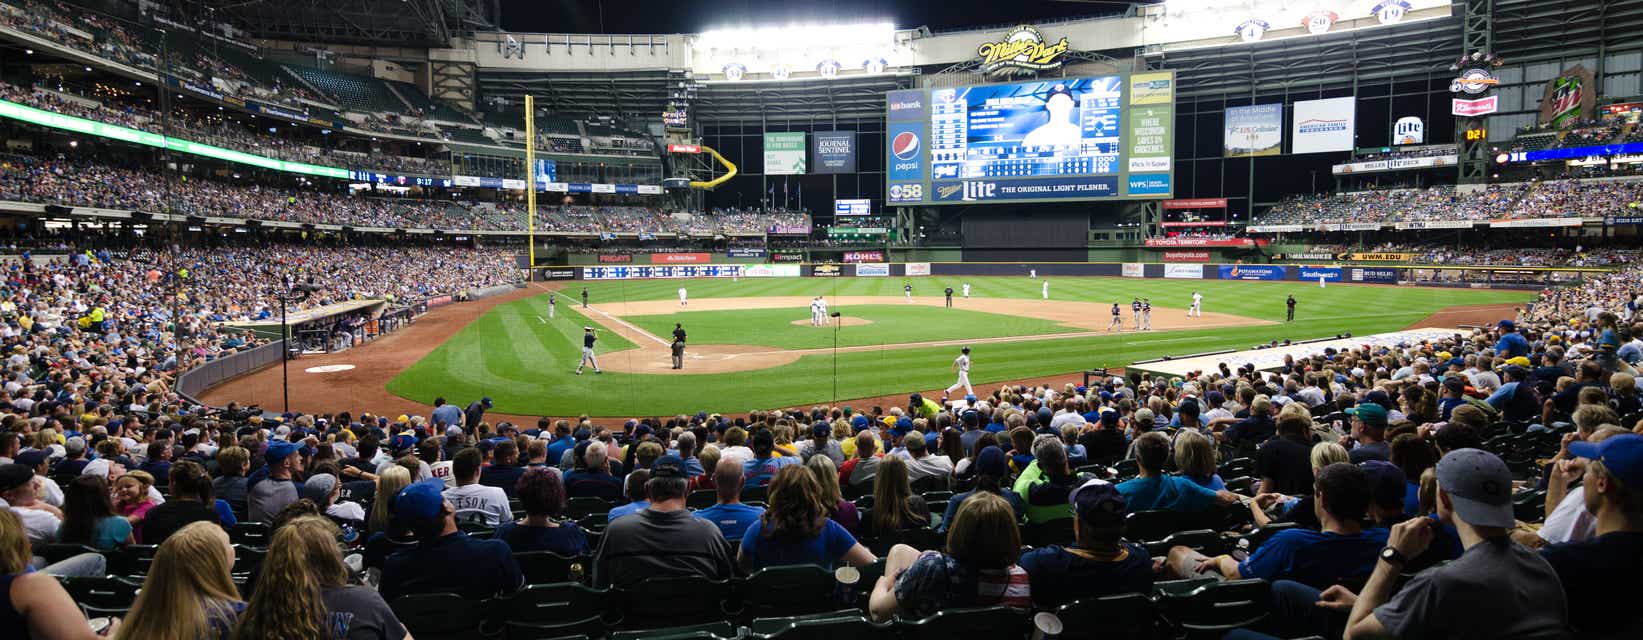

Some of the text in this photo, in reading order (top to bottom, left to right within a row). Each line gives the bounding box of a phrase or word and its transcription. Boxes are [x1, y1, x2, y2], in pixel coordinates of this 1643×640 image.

[1023, 37, 1067, 64] Park
[1398, 122, 1420, 135] Lite
[818, 146, 850, 154] SENTINEL
[896, 161, 918, 172] pepsi
[416, 178, 432, 186] 9:17
[902, 184, 922, 198] 58
[961, 180, 997, 201] Lite
[1017, 185, 1052, 193] ORIGINAL
[1077, 183, 1110, 191] PILSNER.
